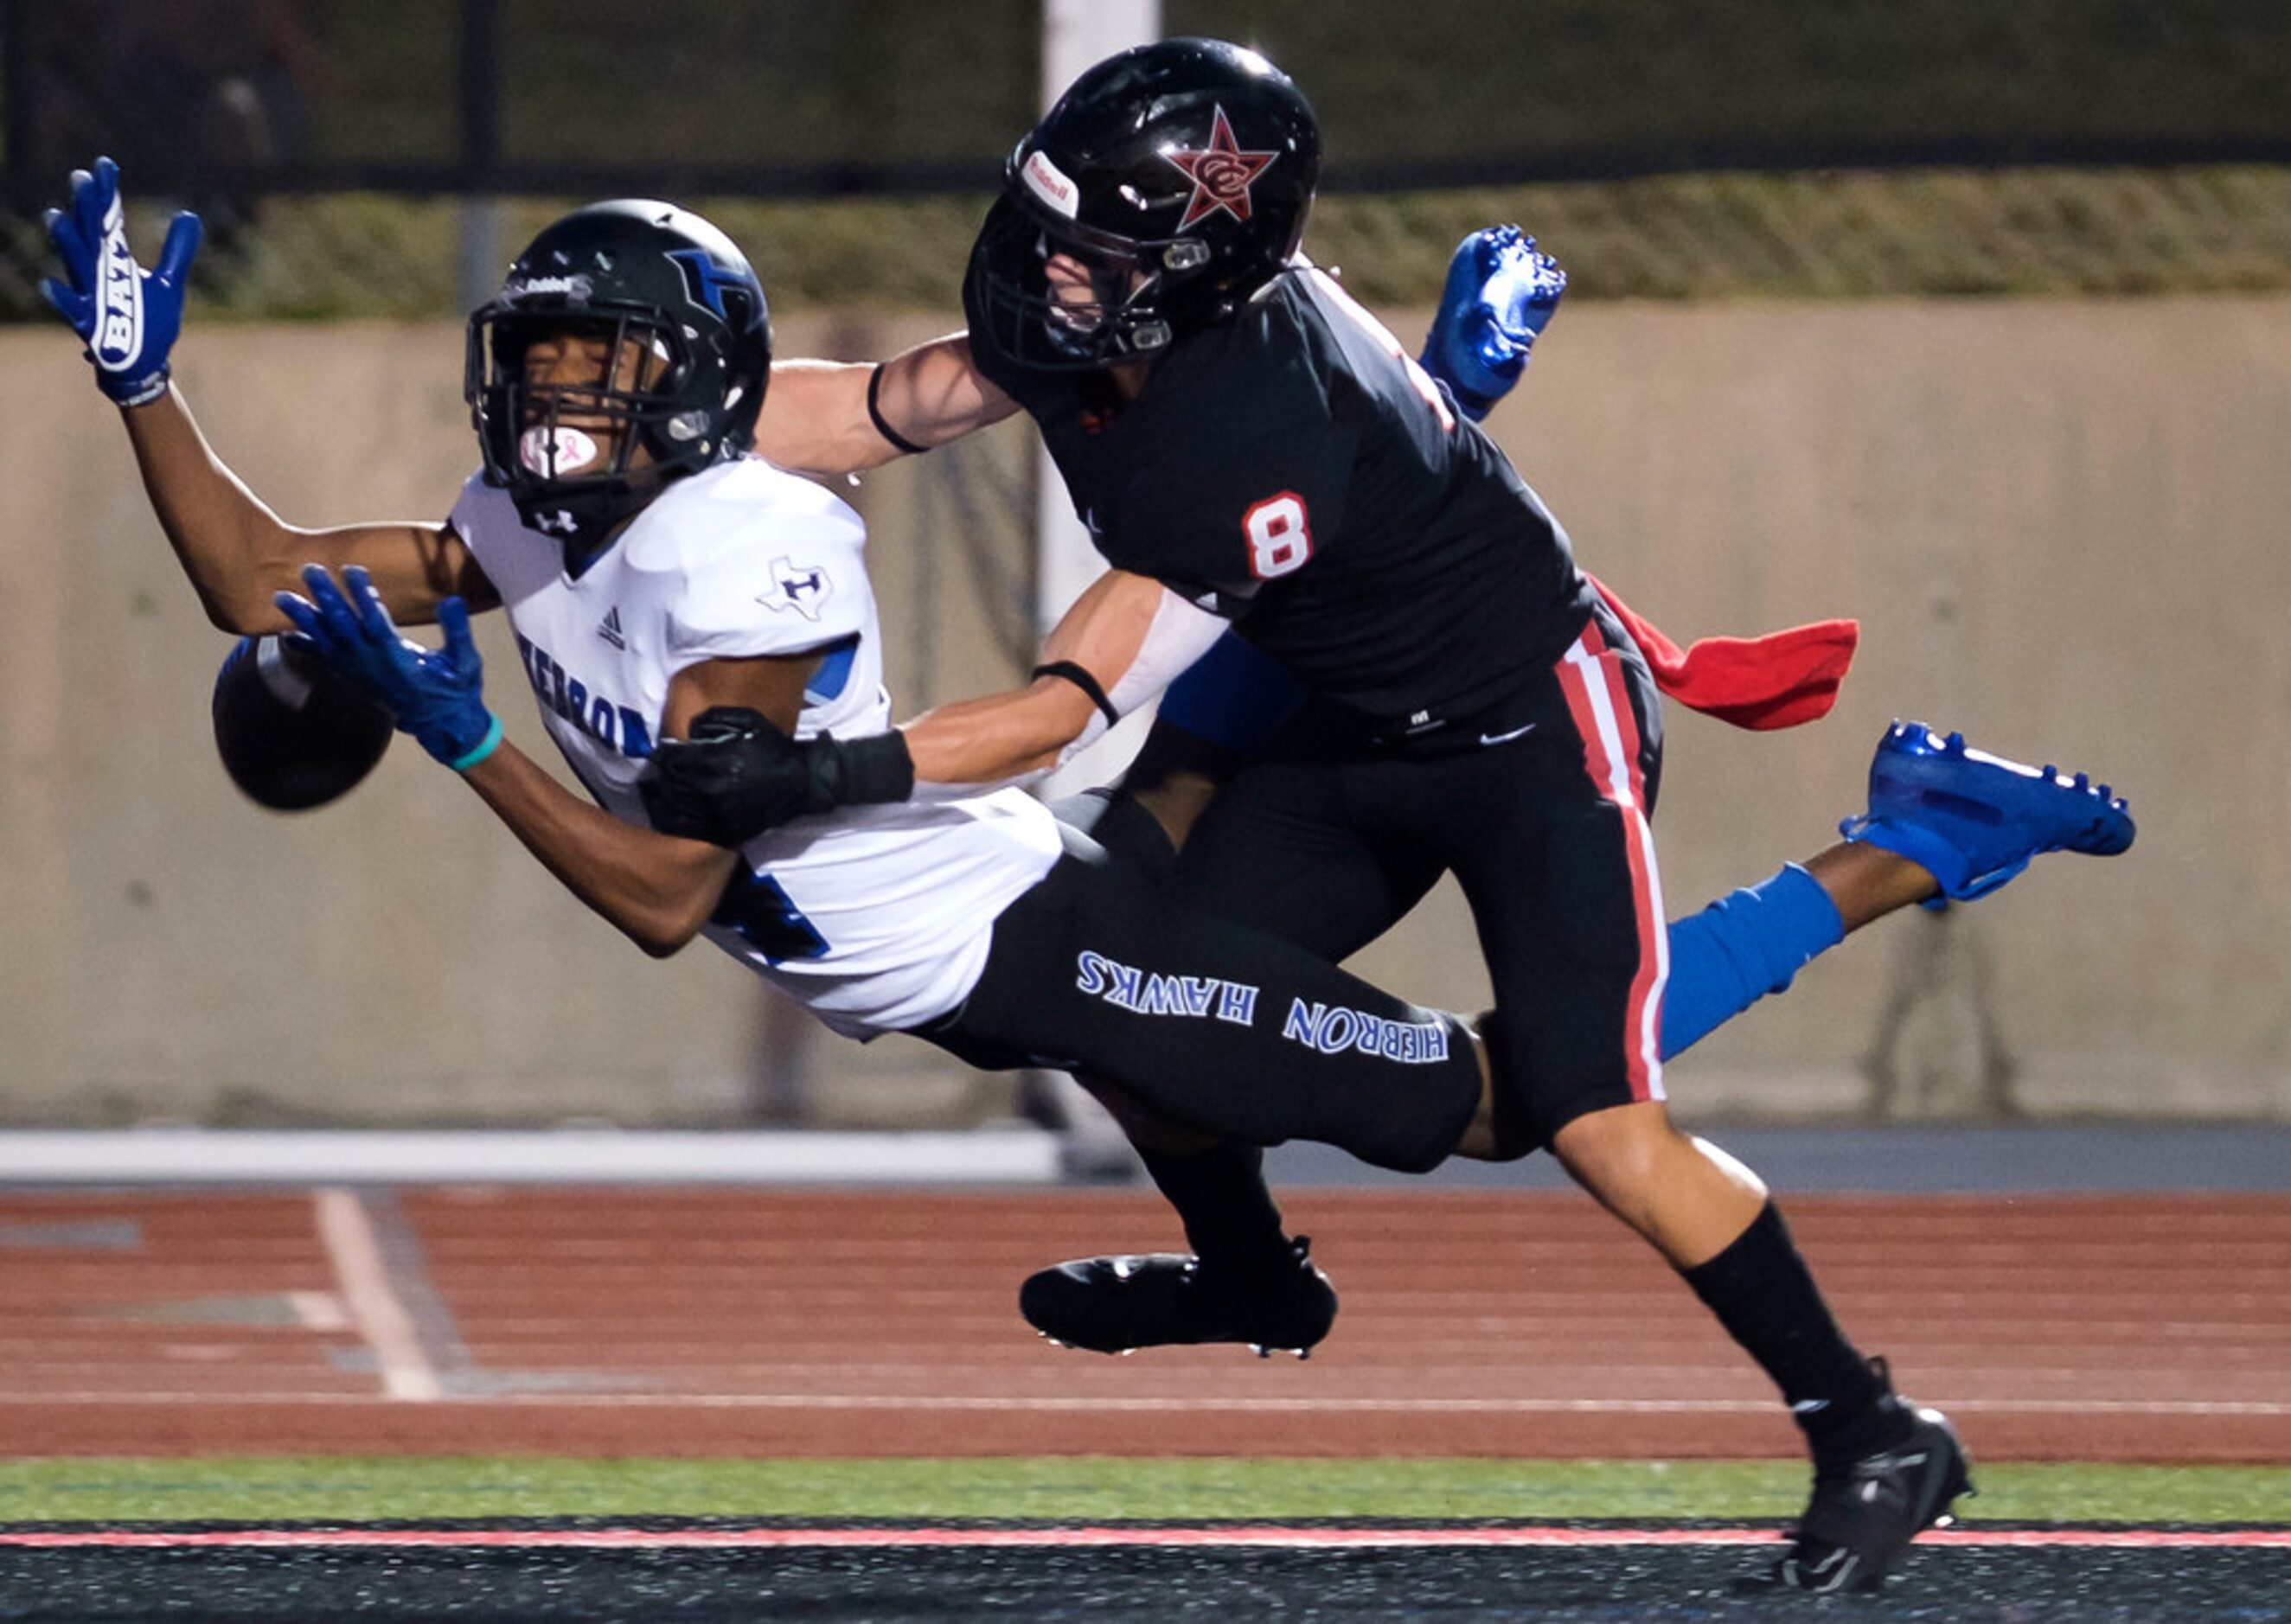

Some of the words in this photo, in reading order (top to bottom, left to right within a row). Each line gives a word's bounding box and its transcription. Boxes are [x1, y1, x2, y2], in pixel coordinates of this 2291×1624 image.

[1241, 489, 1314, 581] 8
[1076, 949, 1260, 1026] HAWKS
[1282, 996, 1449, 1063] HEBRON
